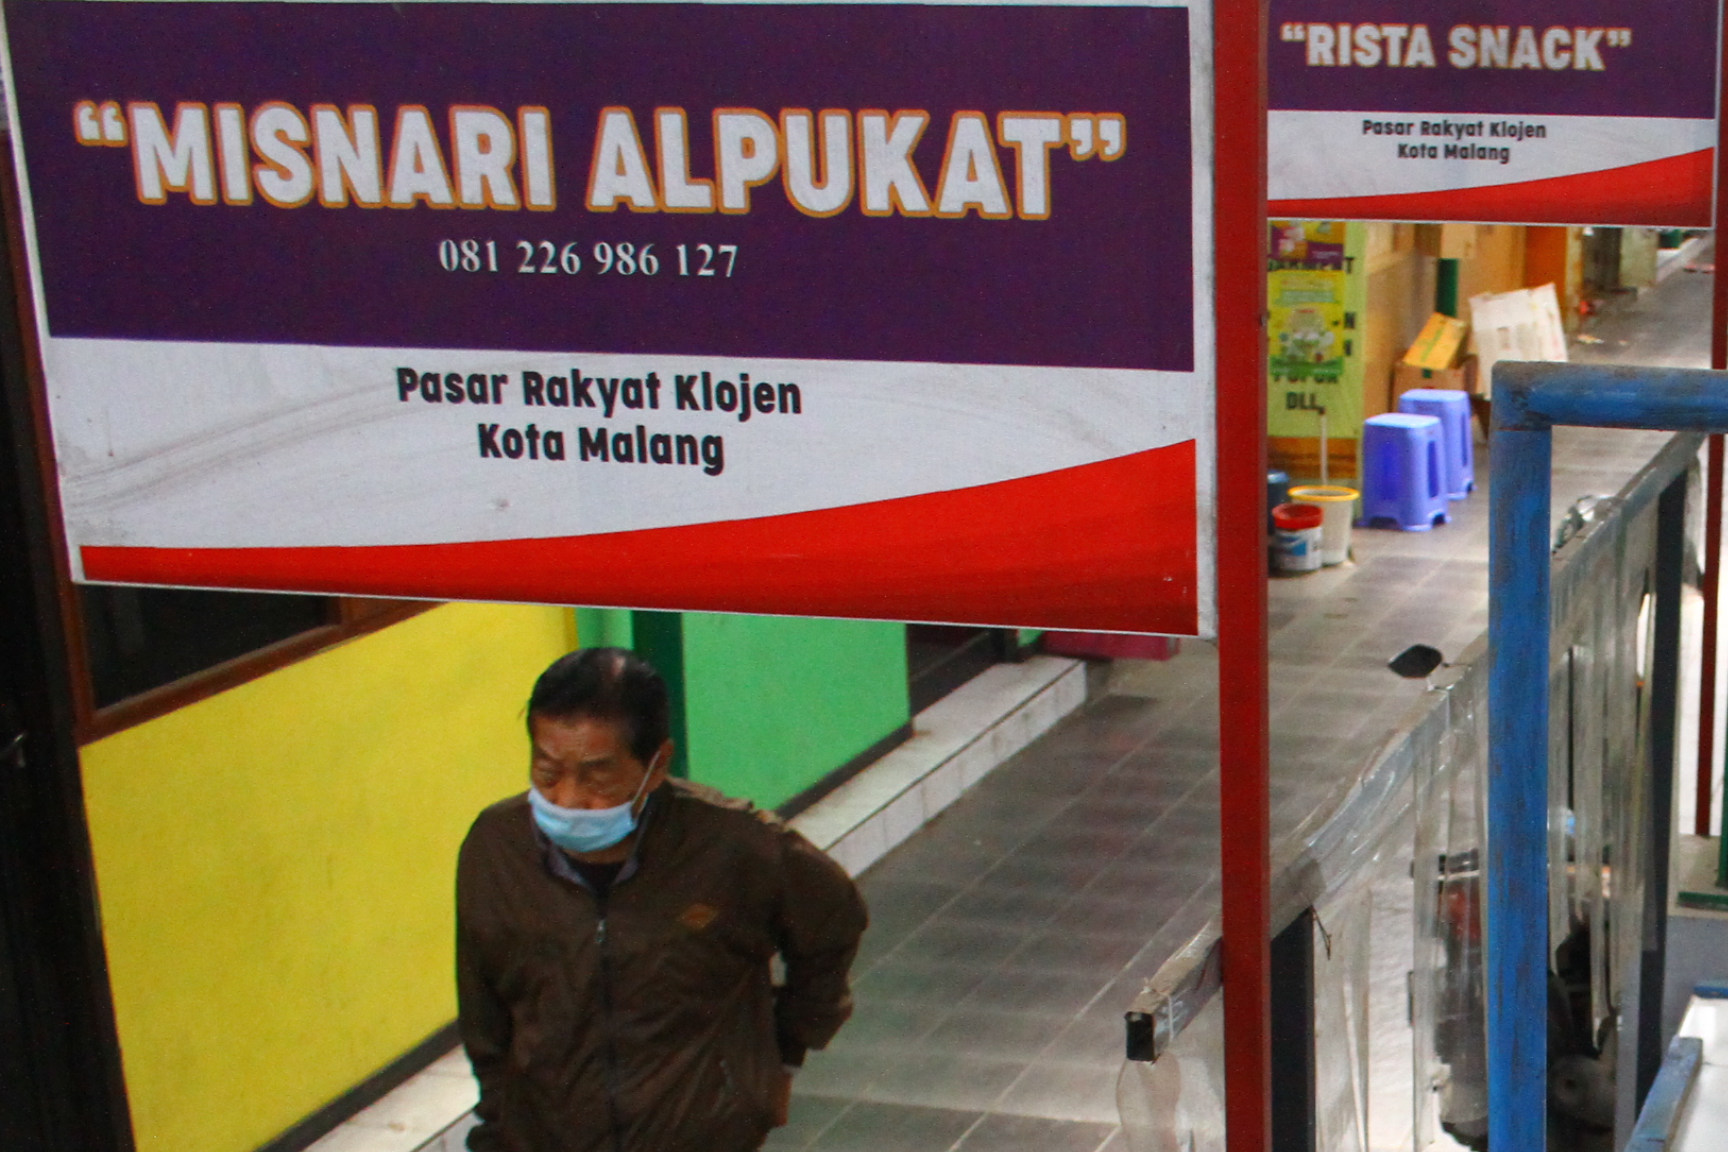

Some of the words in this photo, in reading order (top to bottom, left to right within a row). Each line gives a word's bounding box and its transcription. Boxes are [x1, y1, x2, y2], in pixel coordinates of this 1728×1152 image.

[1362, 119, 1414, 136] Pasar
[1421, 120, 1483, 140] Rakyat
[1490, 121, 1547, 141] Klojen
[73, 99, 557, 212] “MISNARI
[585, 106, 1127, 221] ALPUKAT”
[1398, 143, 1438, 159] Kota
[1444, 144, 1510, 164] Malang
[438, 238, 499, 273] 081
[516, 240, 582, 275] 226
[594, 241, 660, 276] 986
[676, 243, 739, 278] 127
[396, 366, 508, 405] Pasar
[522, 368, 661, 418] Rakyat
[675, 371, 803, 422] Klojen
[478, 423, 566, 462] Kota
[579, 425, 725, 476] Malang
